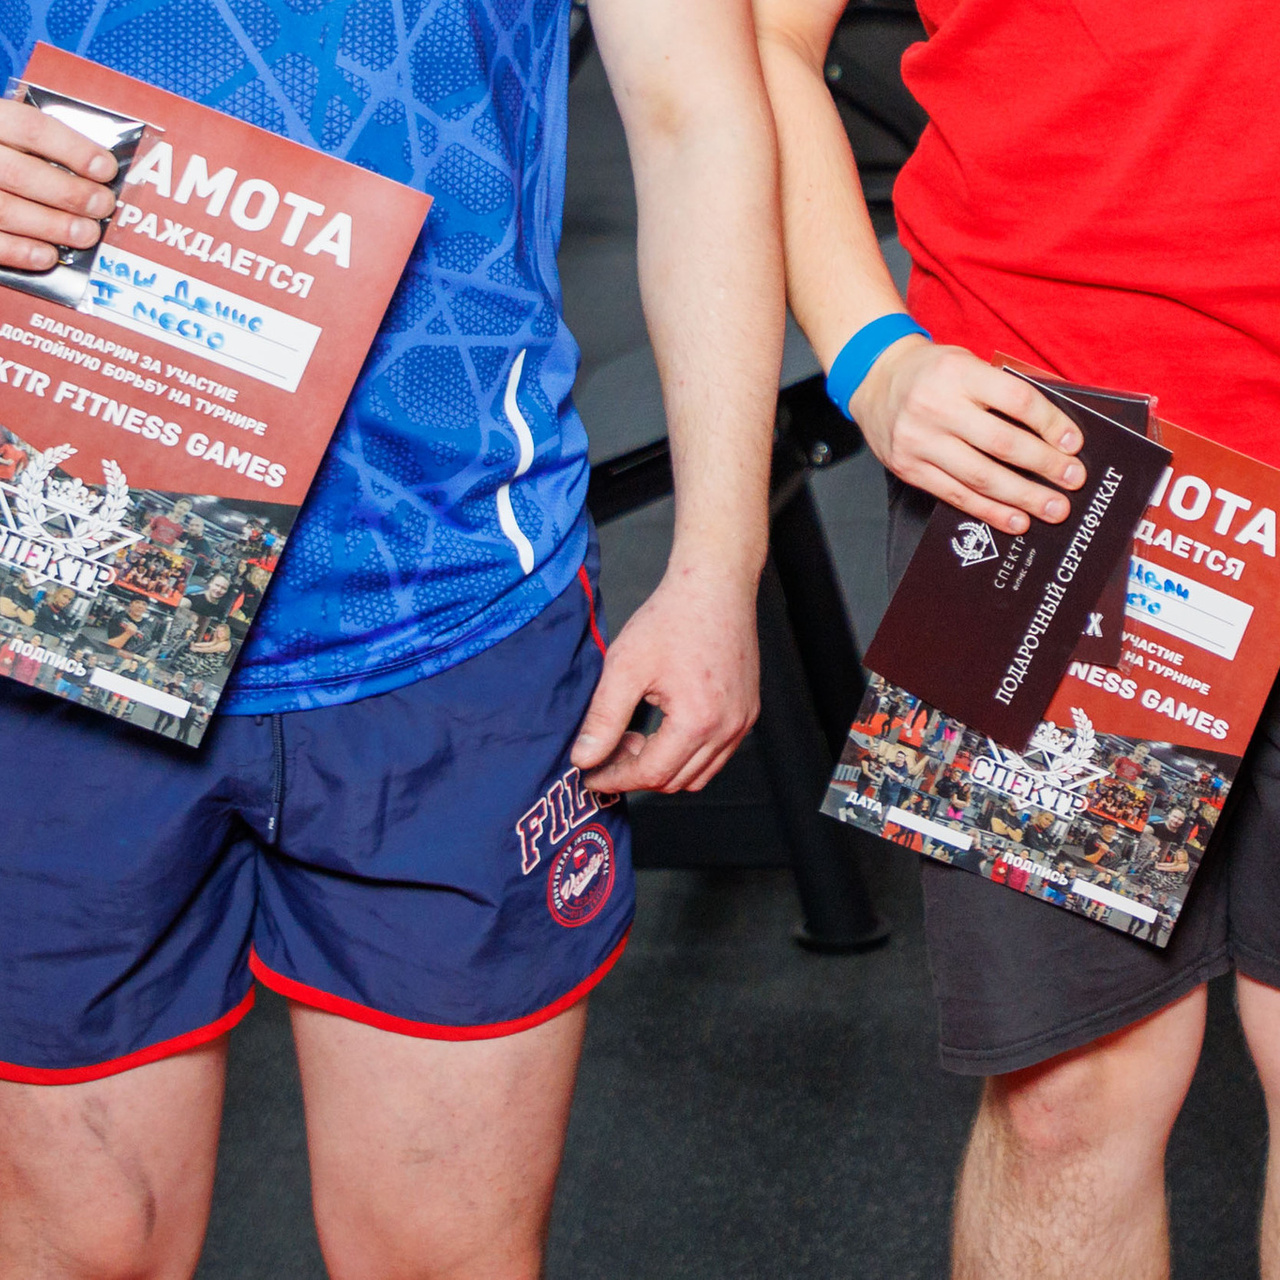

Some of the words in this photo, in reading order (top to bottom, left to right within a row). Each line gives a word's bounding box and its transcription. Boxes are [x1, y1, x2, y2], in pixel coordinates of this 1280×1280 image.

[124, 141, 352, 268] АМОТА
[116, 201, 315, 298] РАЖДАЕТСЯ
[0, 323, 101, 371] ДОСТОЙНУЮ
[102, 362, 164, 395] БОРЬБУ
[168, 389, 191, 408] НА
[195, 397, 268, 436] ТУРНИРЕ
[29, 312, 140, 364] БЛАГОДАРИМ
[140, 355, 164, 375] ЗА
[165, 363, 239, 402] УЧАСТИЕ
[0, 357, 51, 397] KTR
[53, 381, 182, 447] FITNESS
[186, 431, 287, 488] GAMES
[0, 529, 116, 593] ПЕКТР
[994, 535, 1026, 589] СПЕКТР
[1133, 519, 1246, 581] ДАЕТСЯ
[995, 582, 1067, 705] ПОДАРОЧНЫЙ
[1057, 467, 1123, 584] СЕРТИФИКАТ
[8, 638, 87, 677] ПОДПИСЬ
[1121, 631, 1185, 666] УЧАСТИЕ
[1124, 650, 1144, 667] НА
[1147, 659, 1211, 696] ТУРНИРЕ
[1068, 662, 1138, 700] NESS
[1141, 688, 1229, 740] GAMES
[516, 767, 620, 875] FIL
[845, 791, 882, 813] ДАТА
[971, 757, 1087, 818] СПЕКТР
